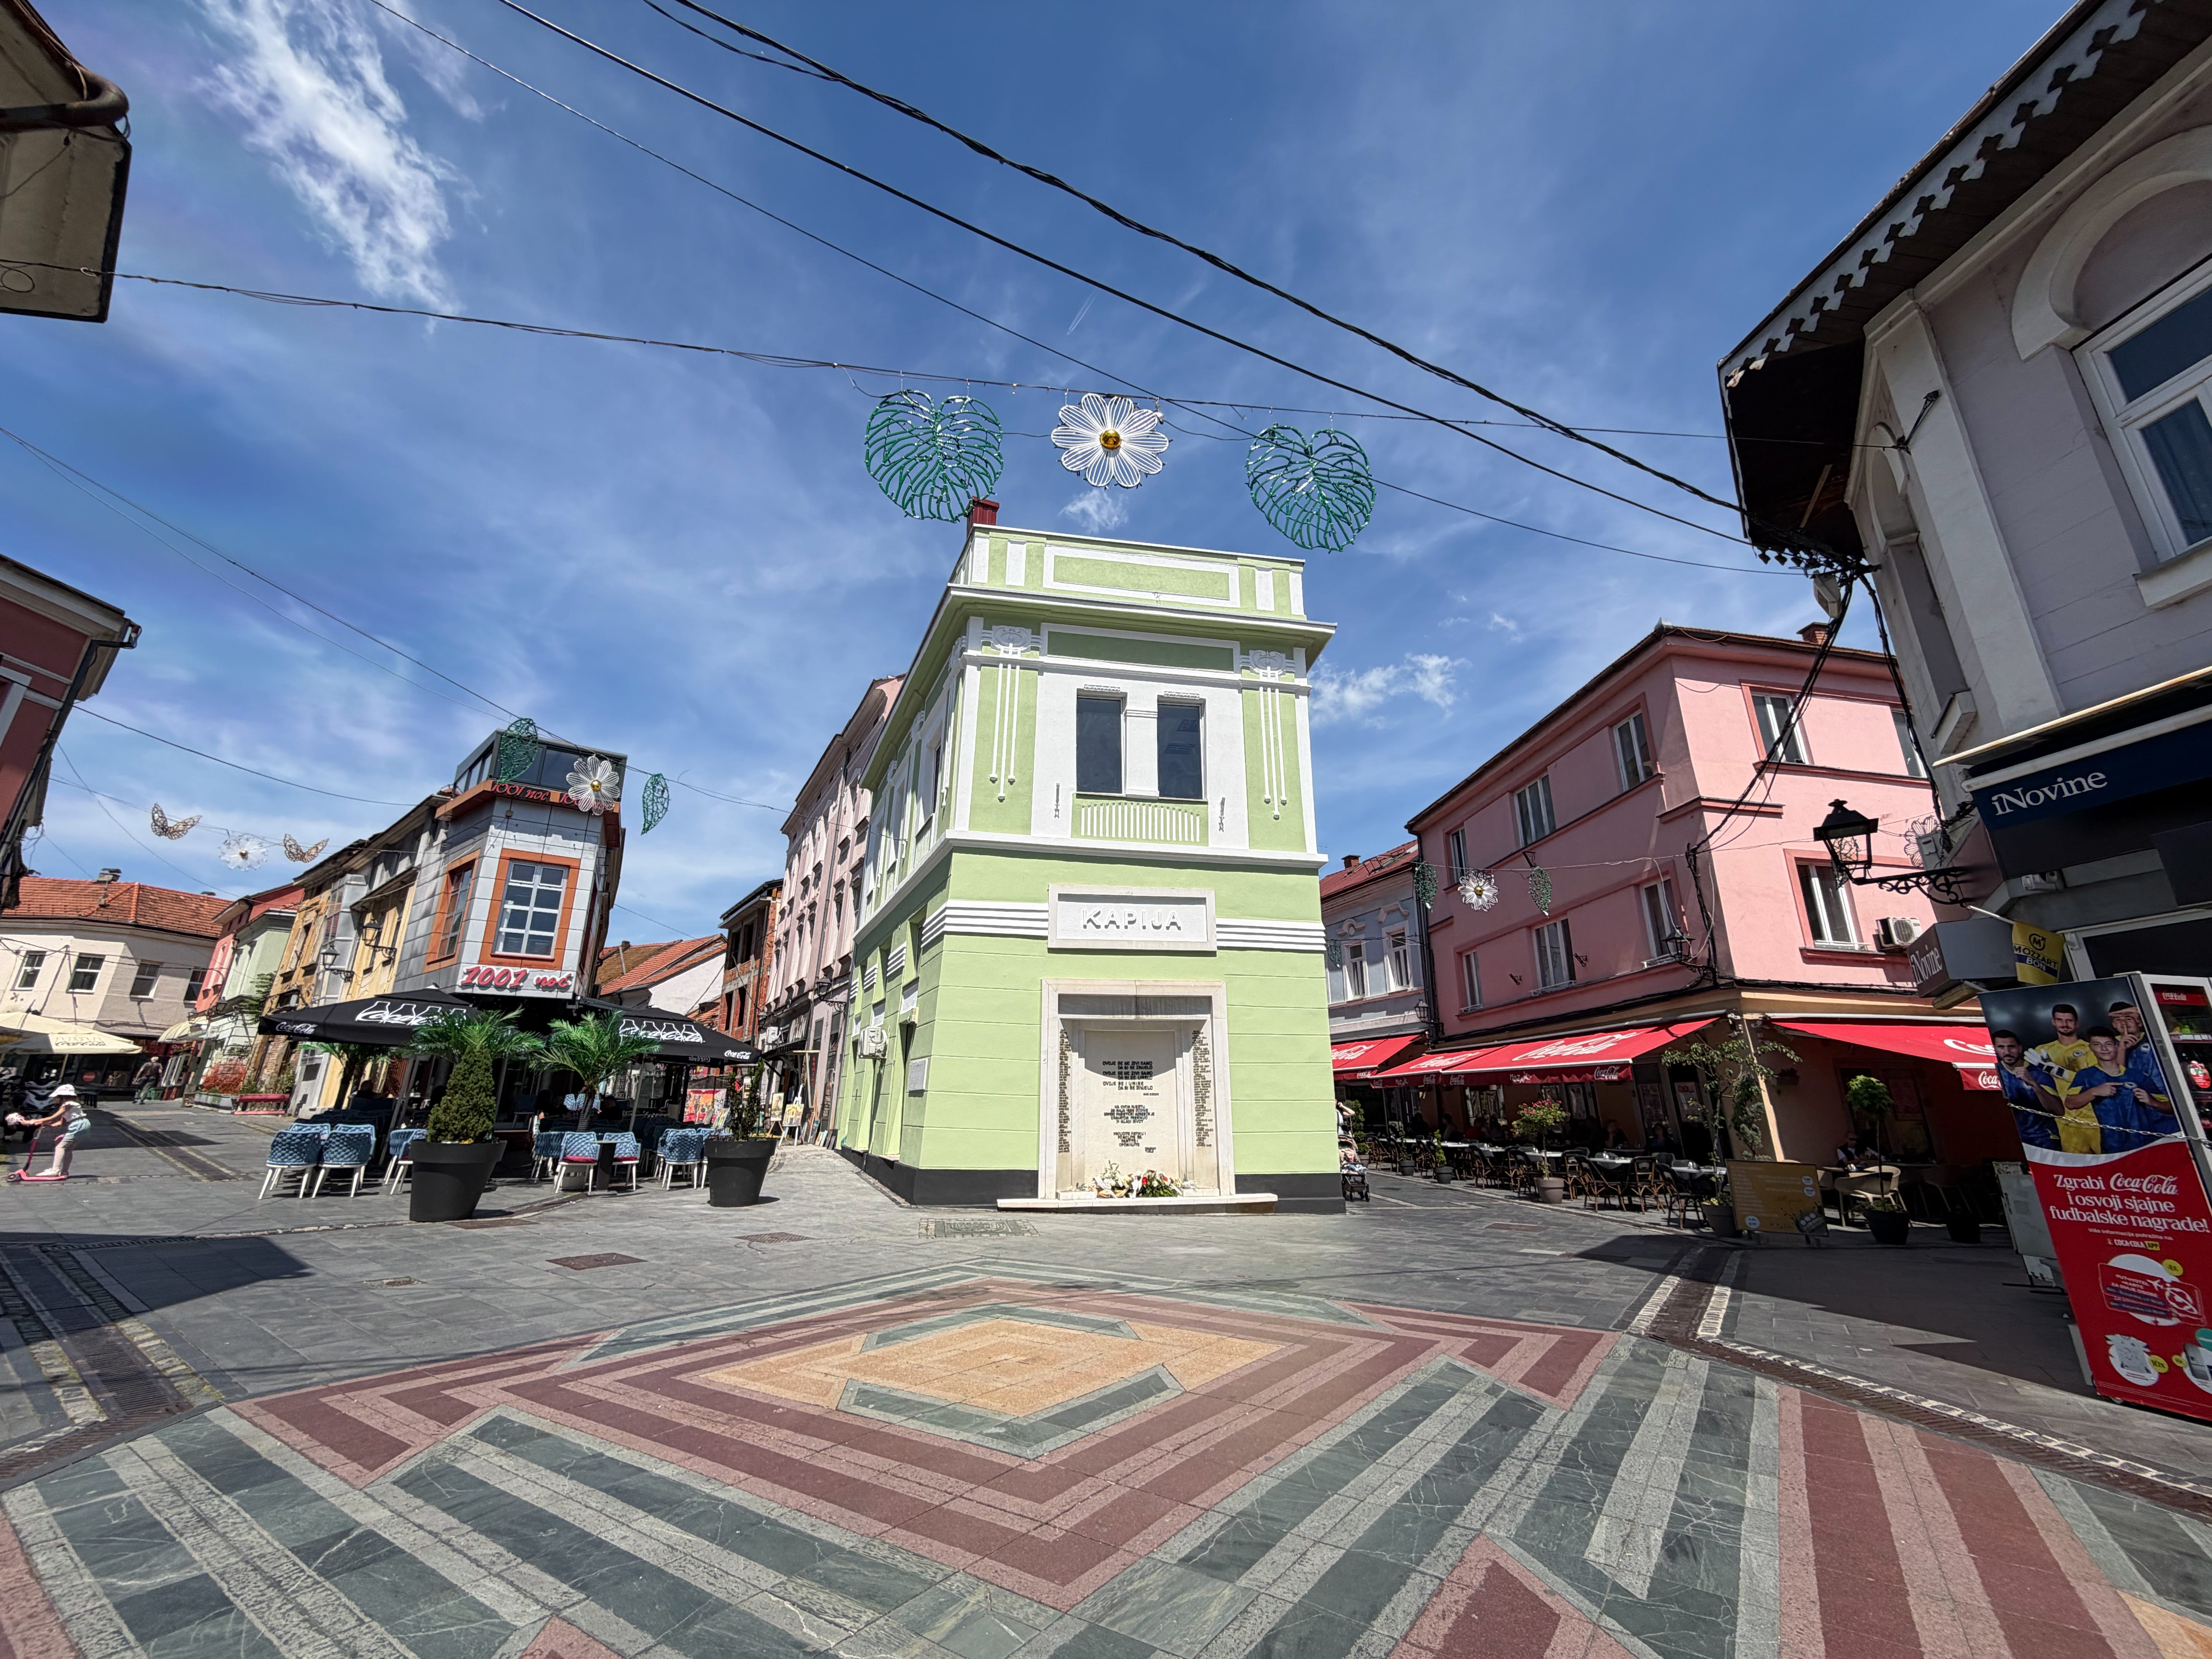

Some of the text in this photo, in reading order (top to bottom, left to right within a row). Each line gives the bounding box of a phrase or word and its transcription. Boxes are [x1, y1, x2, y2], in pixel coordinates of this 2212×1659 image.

[491, 783, 525, 795] 1001
[1991, 772, 2108, 816] iNovine
[1083, 909, 1182, 931] KAPIJA
[1910, 944, 1942, 985] iNovine
[2014, 945, 2057, 967] MOZZART
[2026, 958, 2046, 971] BON
[460, 965, 573, 988] 1001 noć
[275, 1021, 318, 1035] Coca-Cola
[724, 1050, 752, 1060] Coca-Cola
[1594, 1065, 1620, 1080] Coca-Cola
[2054, 1173, 2179, 1195] Zgrabi Coca-Cola
[2066, 1192, 2176, 1214] i osvoji sjajne
[2049, 1206, 2211, 1233] fudbalske nagrade!
[2114, 1239, 2147, 1249] COCA-COLA
